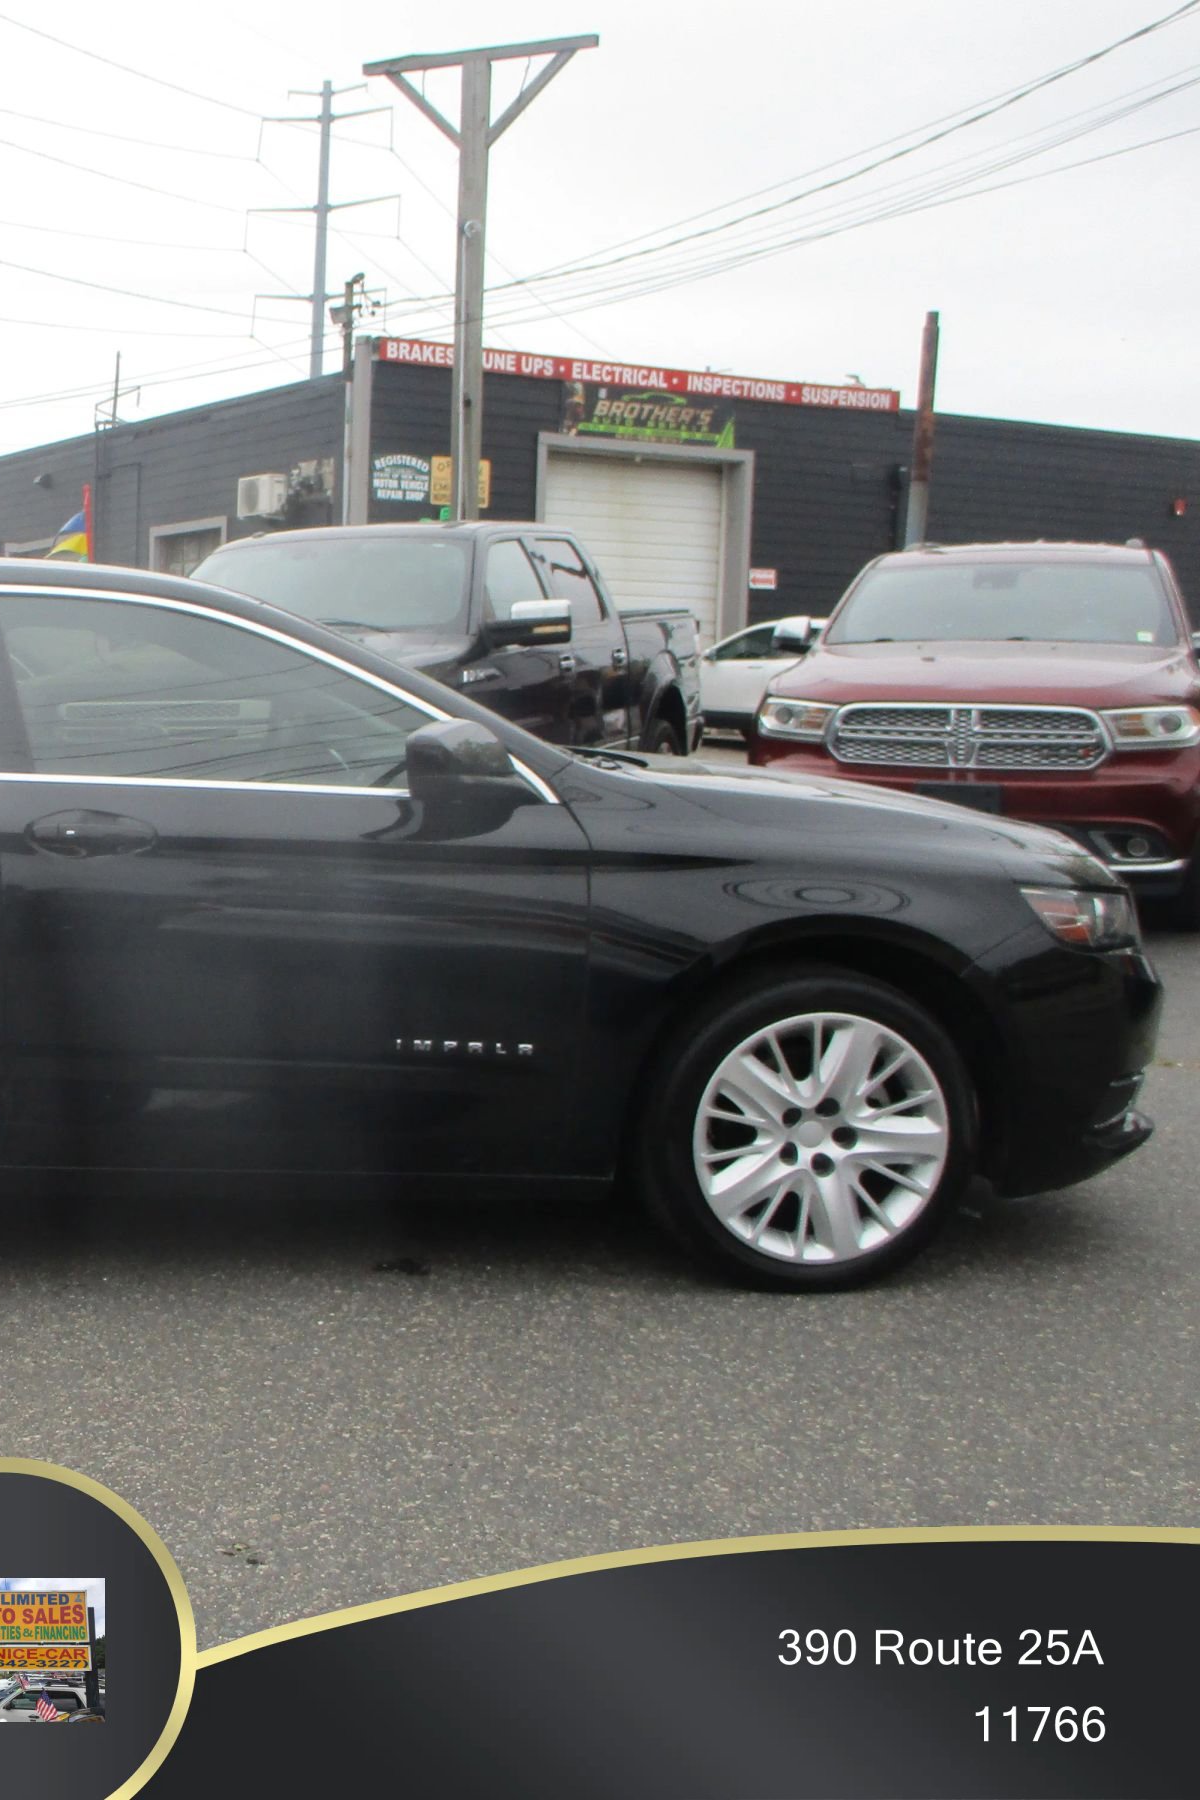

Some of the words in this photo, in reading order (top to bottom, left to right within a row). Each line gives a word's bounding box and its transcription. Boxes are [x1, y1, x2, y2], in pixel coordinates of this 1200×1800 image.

[386, 341, 455, 366] BRAKES
[482, 350, 517, 372] UNE
[521, 356, 555, 376] UPS
[571, 361, 668, 388] ELECTRICAL
[687, 375, 786, 401] INSPECTIONS
[801, 386, 892, 409] SUSPENSION
[593, 400, 715, 426] BROTHER'S
[374, 454, 430, 473] REGISTERED
[373, 479, 399, 489] MOTOR
[400, 480, 429, 492] VEHICLE
[377, 488, 404, 500] REPAIR
[405, 490, 426, 502] SHOP
[396, 1038, 534, 1056] IMPALA
